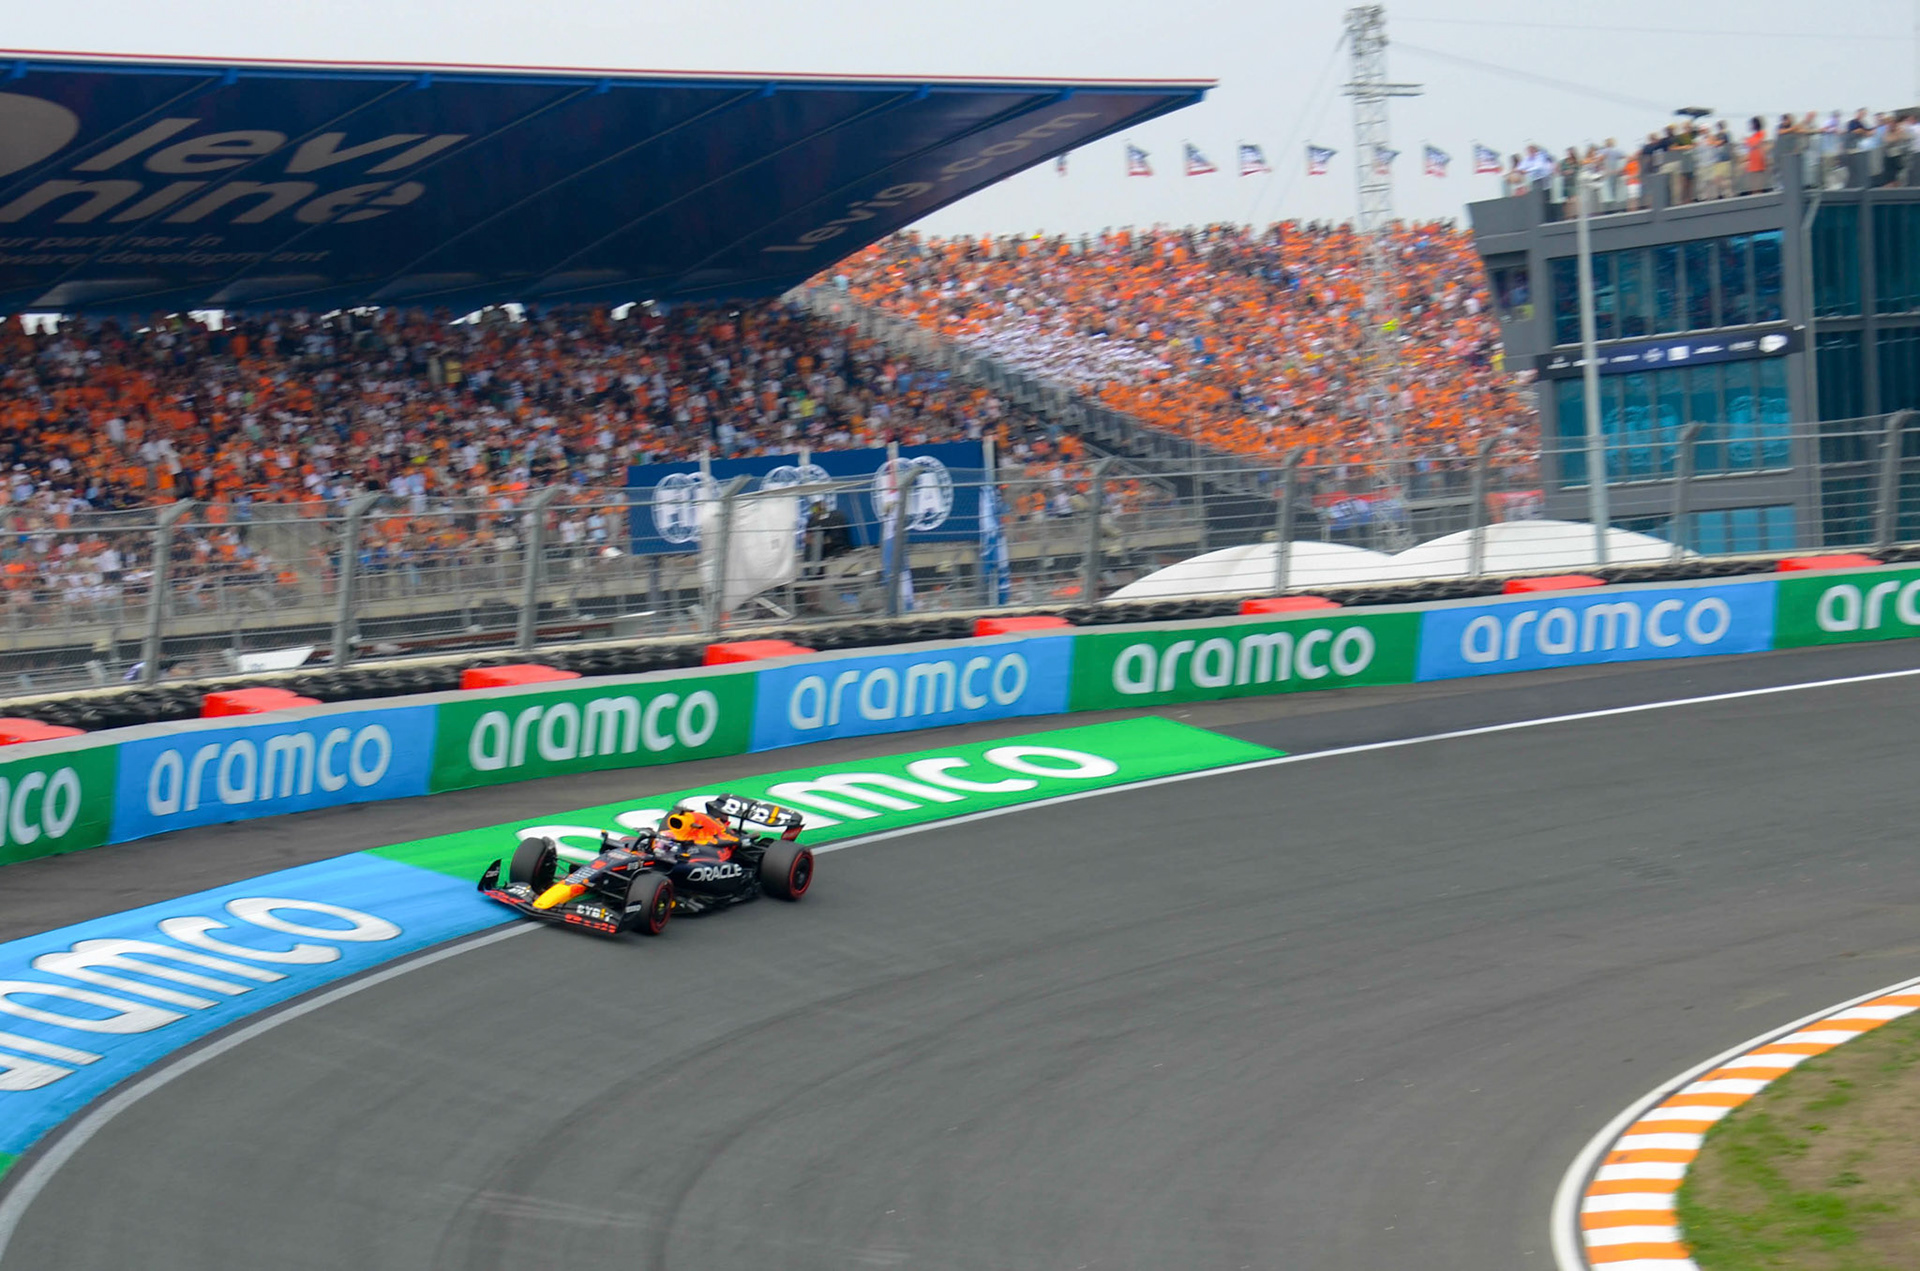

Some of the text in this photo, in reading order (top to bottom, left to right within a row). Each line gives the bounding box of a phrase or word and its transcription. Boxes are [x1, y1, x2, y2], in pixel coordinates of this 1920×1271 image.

[1112, 625, 1375, 695] aramco
[1460, 597, 1731, 664] aramco
[788, 652, 1029, 730] aramco
[469, 690, 719, 771] aramco
[0, 766, 82, 846] co
[147, 724, 392, 816] aramco
[687, 863, 743, 882] ORACLE
